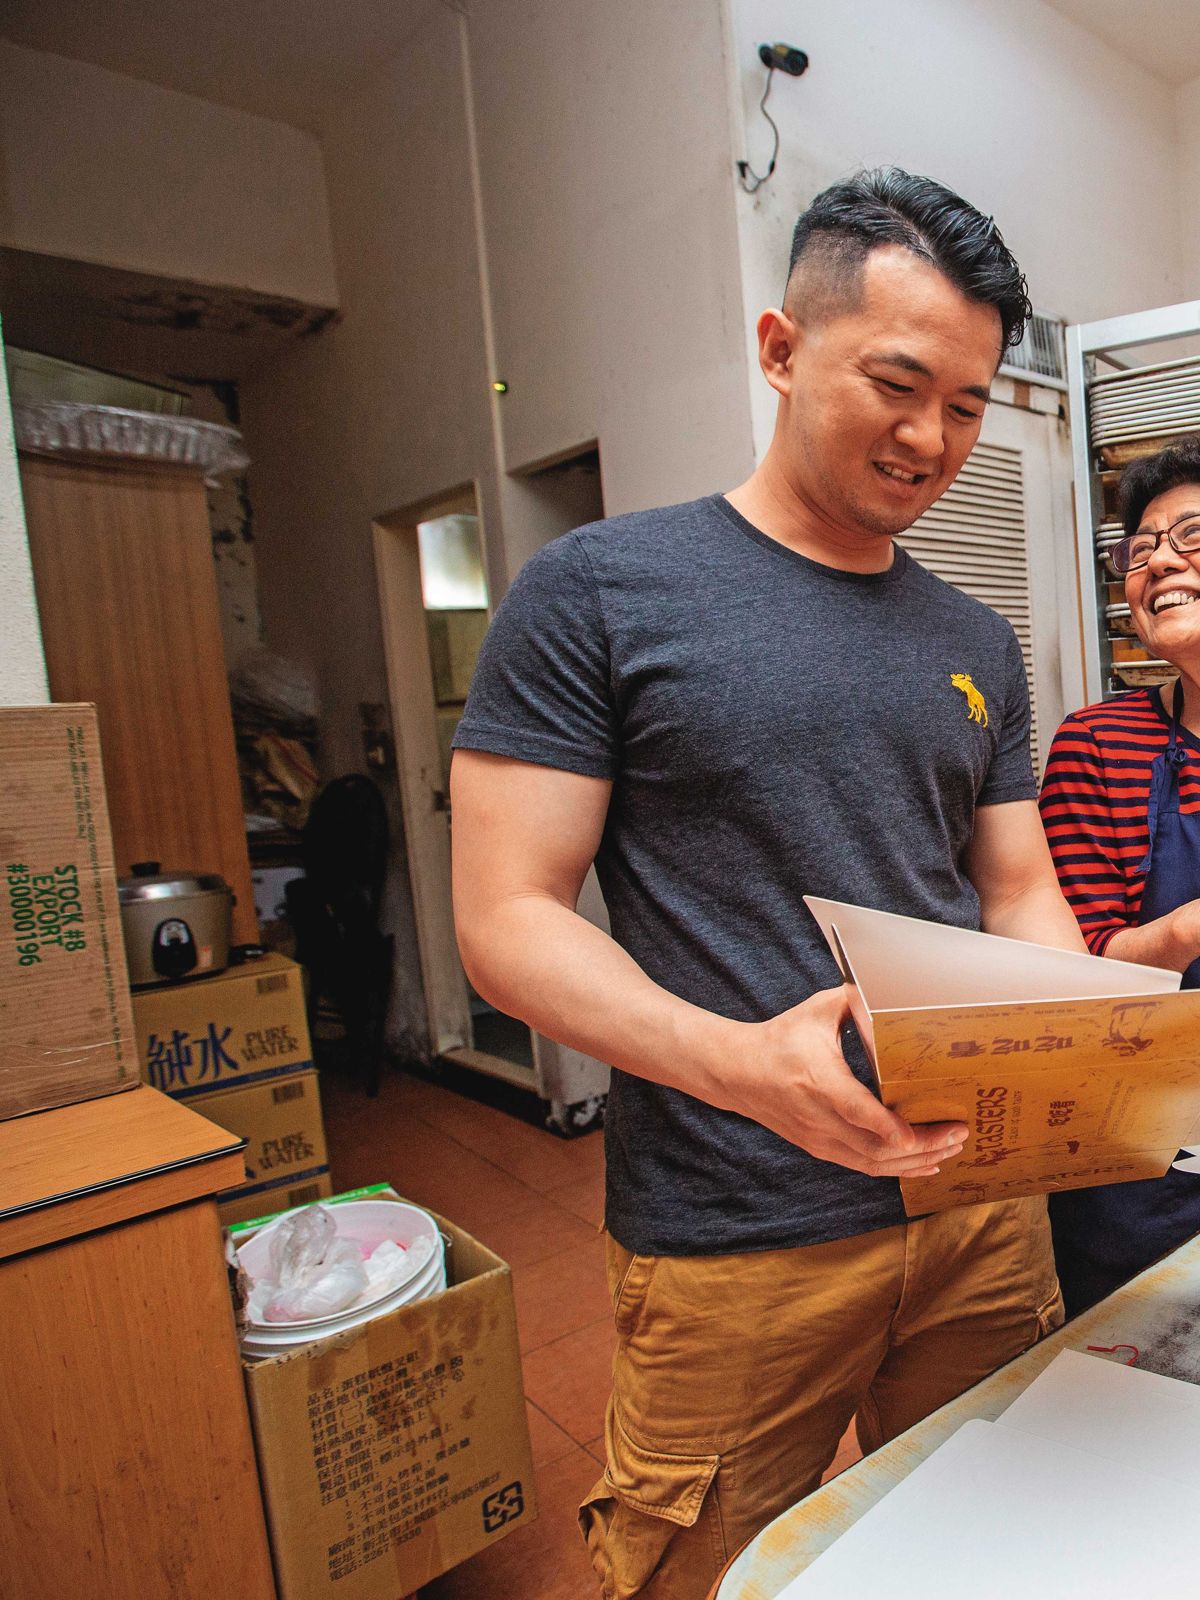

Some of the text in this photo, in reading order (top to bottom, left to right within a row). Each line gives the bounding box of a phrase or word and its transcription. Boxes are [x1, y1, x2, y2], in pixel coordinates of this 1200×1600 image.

[6, 863, 42, 967] #30000196
[32, 875, 64, 946] EXPORT
[54, 864, 86, 952] STOCK #8
[146, 1022, 239, 1091] 純水
[241, 1035, 299, 1062] WATER
[245, 1025, 292, 1046] PURE
[948, 1036, 1074, 1059] 吃吃看
[262, 1130, 304, 1153] PURE
[975, 1086, 1008, 1152] TASTERS
[258, 1143, 315, 1170] WATER
